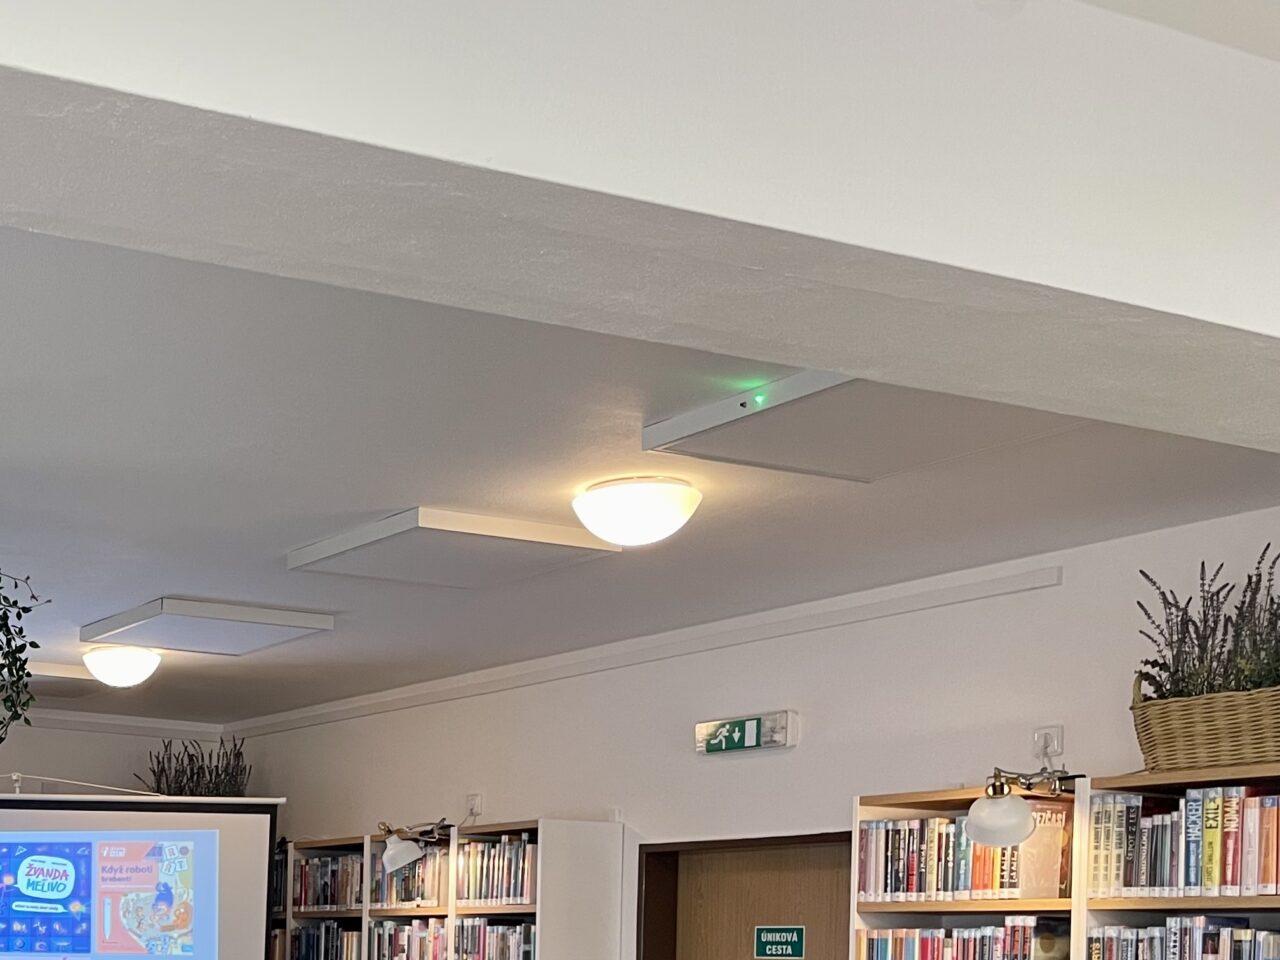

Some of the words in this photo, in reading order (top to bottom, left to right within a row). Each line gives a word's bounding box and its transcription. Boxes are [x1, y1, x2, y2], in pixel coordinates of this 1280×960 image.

[1187, 802, 1202, 840] HACKER
[1205, 804, 1219, 829] EXIL
[1140, 828, 1148, 885] DEMONOLOGI
[25, 862, 69, 881] ŽVANDA
[102, 865, 124, 876] Když
[26, 879, 67, 893] MELIVO
[761, 930, 798, 942] ÚNIKOVÁ
[766, 945, 792, 955] CESTA
